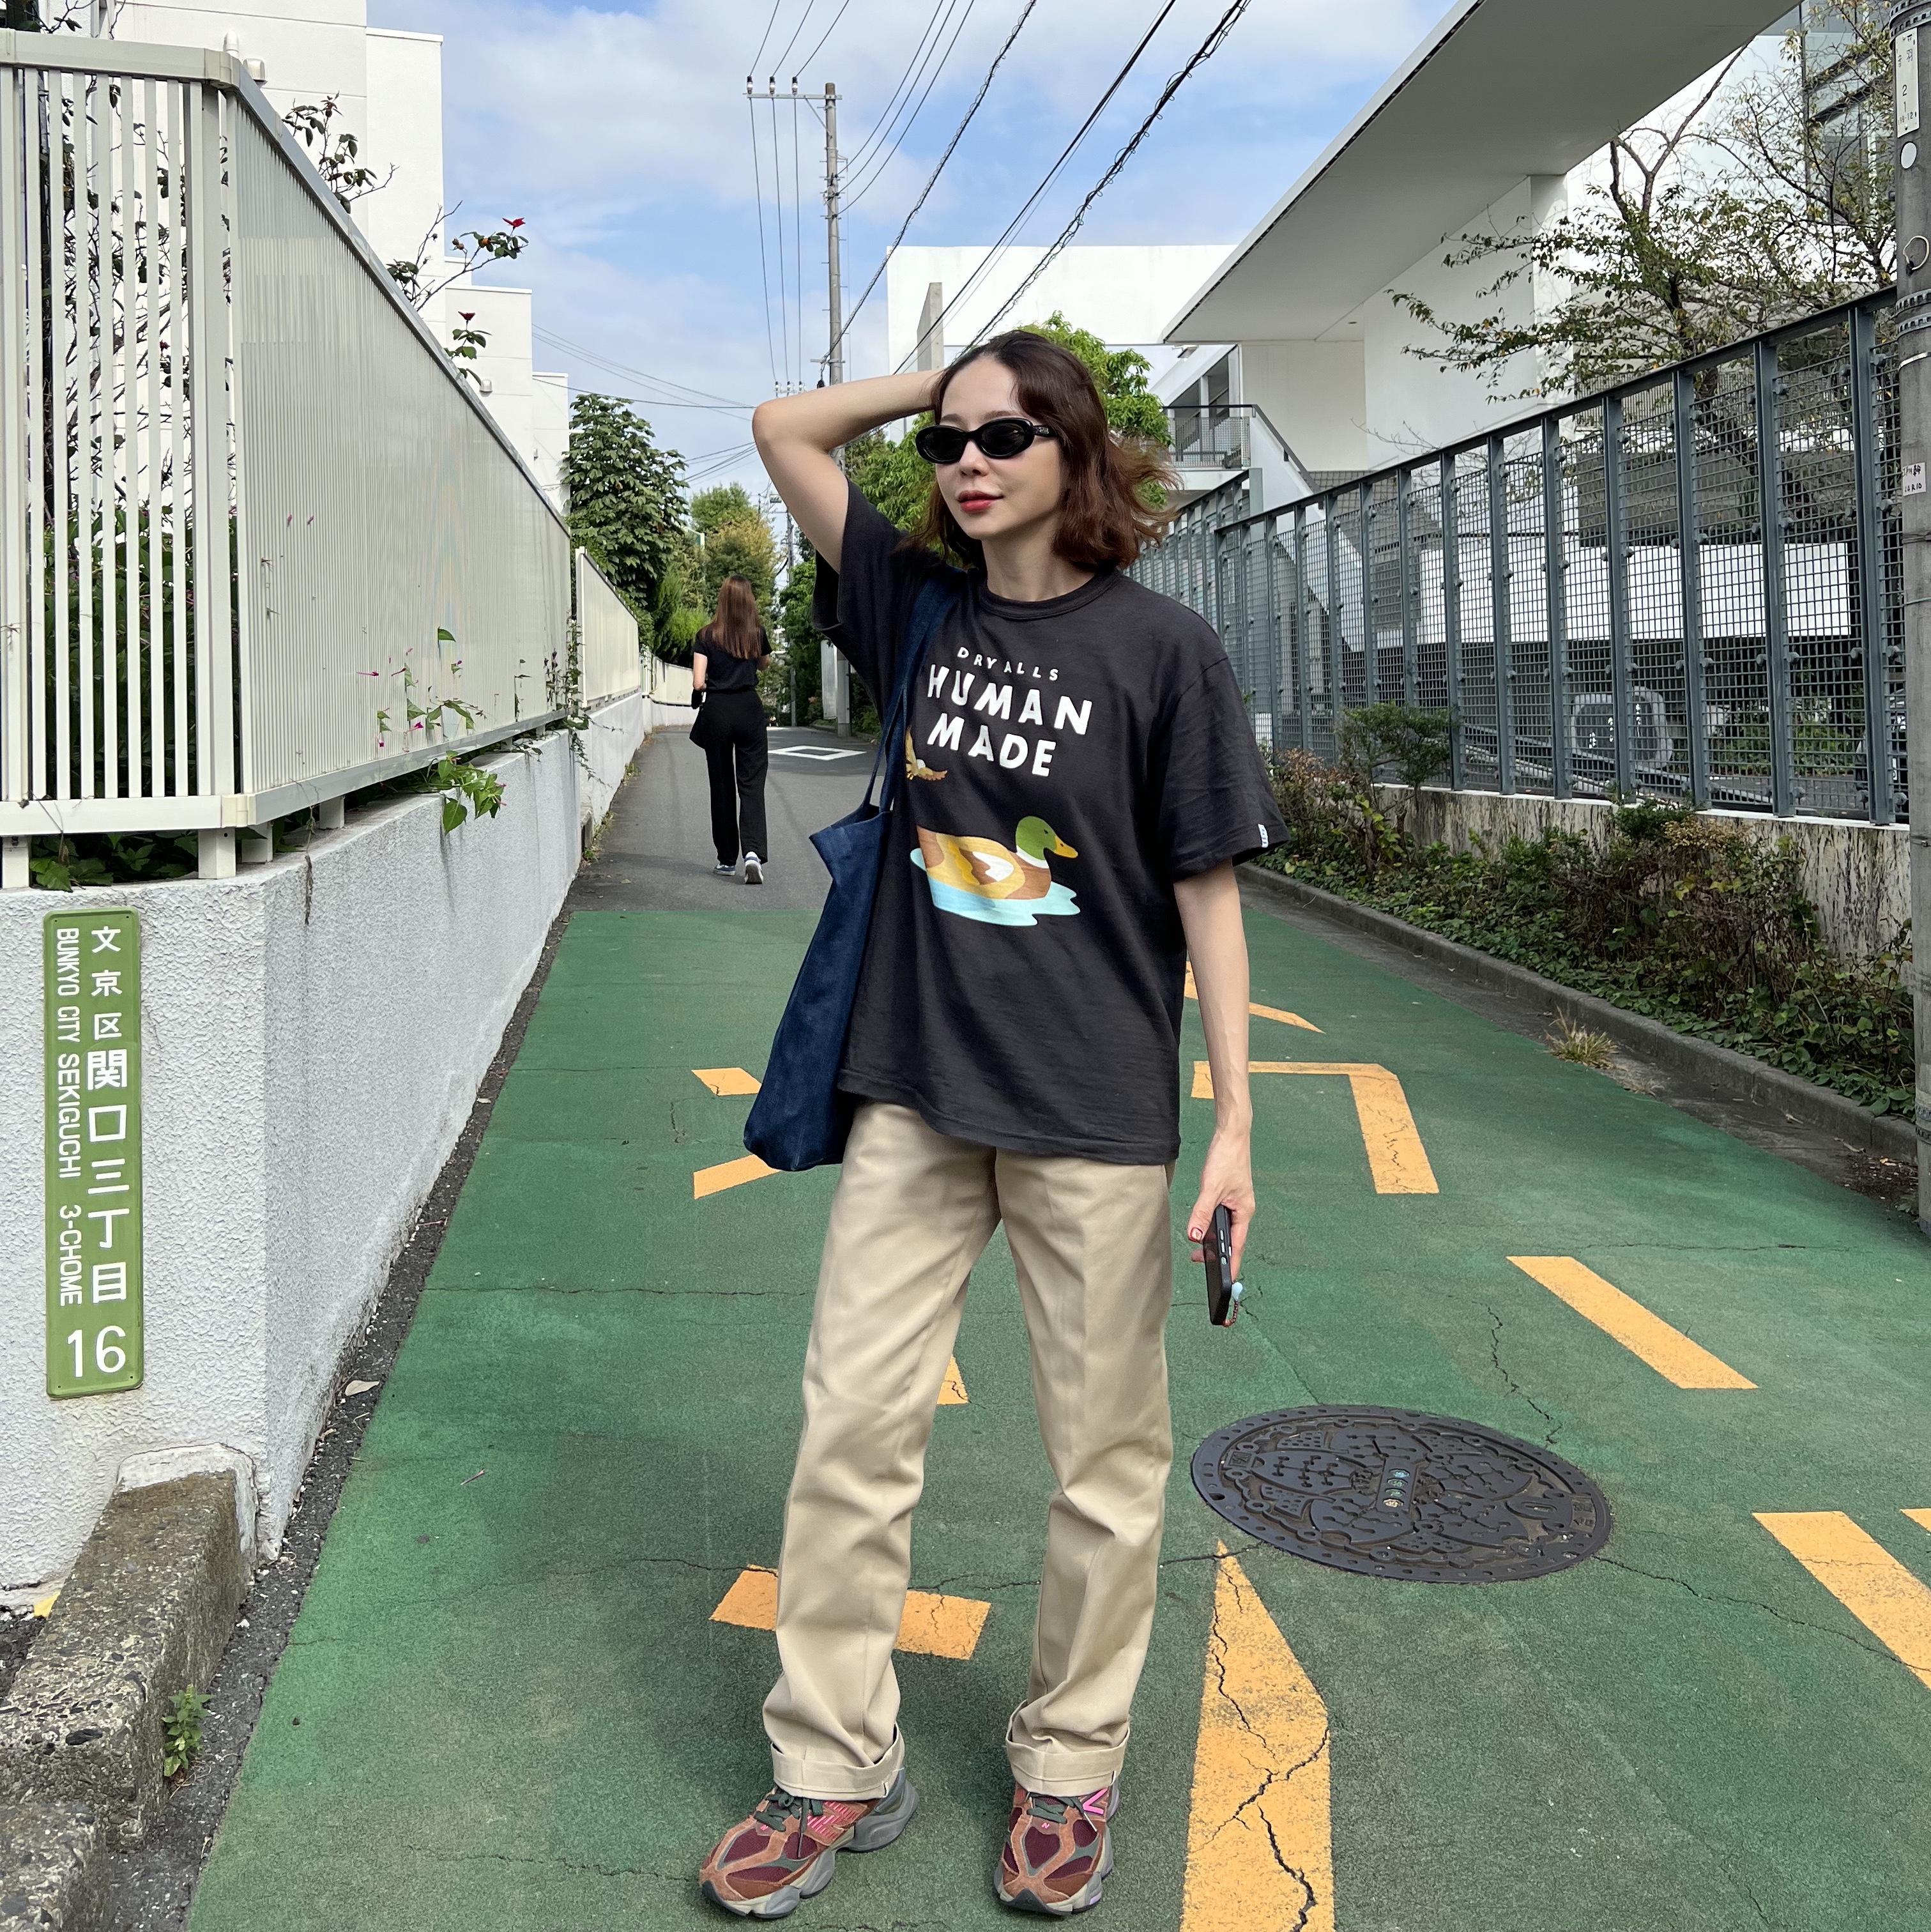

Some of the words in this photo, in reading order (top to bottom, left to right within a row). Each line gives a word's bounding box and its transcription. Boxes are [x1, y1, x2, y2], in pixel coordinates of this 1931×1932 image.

[1902, 84, 1907, 96] 2
[927, 664, 1092, 735] HUMAN
[927, 712, 1057, 777] MADE
[56, 928, 80, 996] BUNKYO
[57, 1006, 80, 1043] CITY
[57, 1053, 81, 1178] SEKIGUCHI
[59, 1204, 82, 1307] 3-CHOME
[67, 1325, 126, 1377] 16
